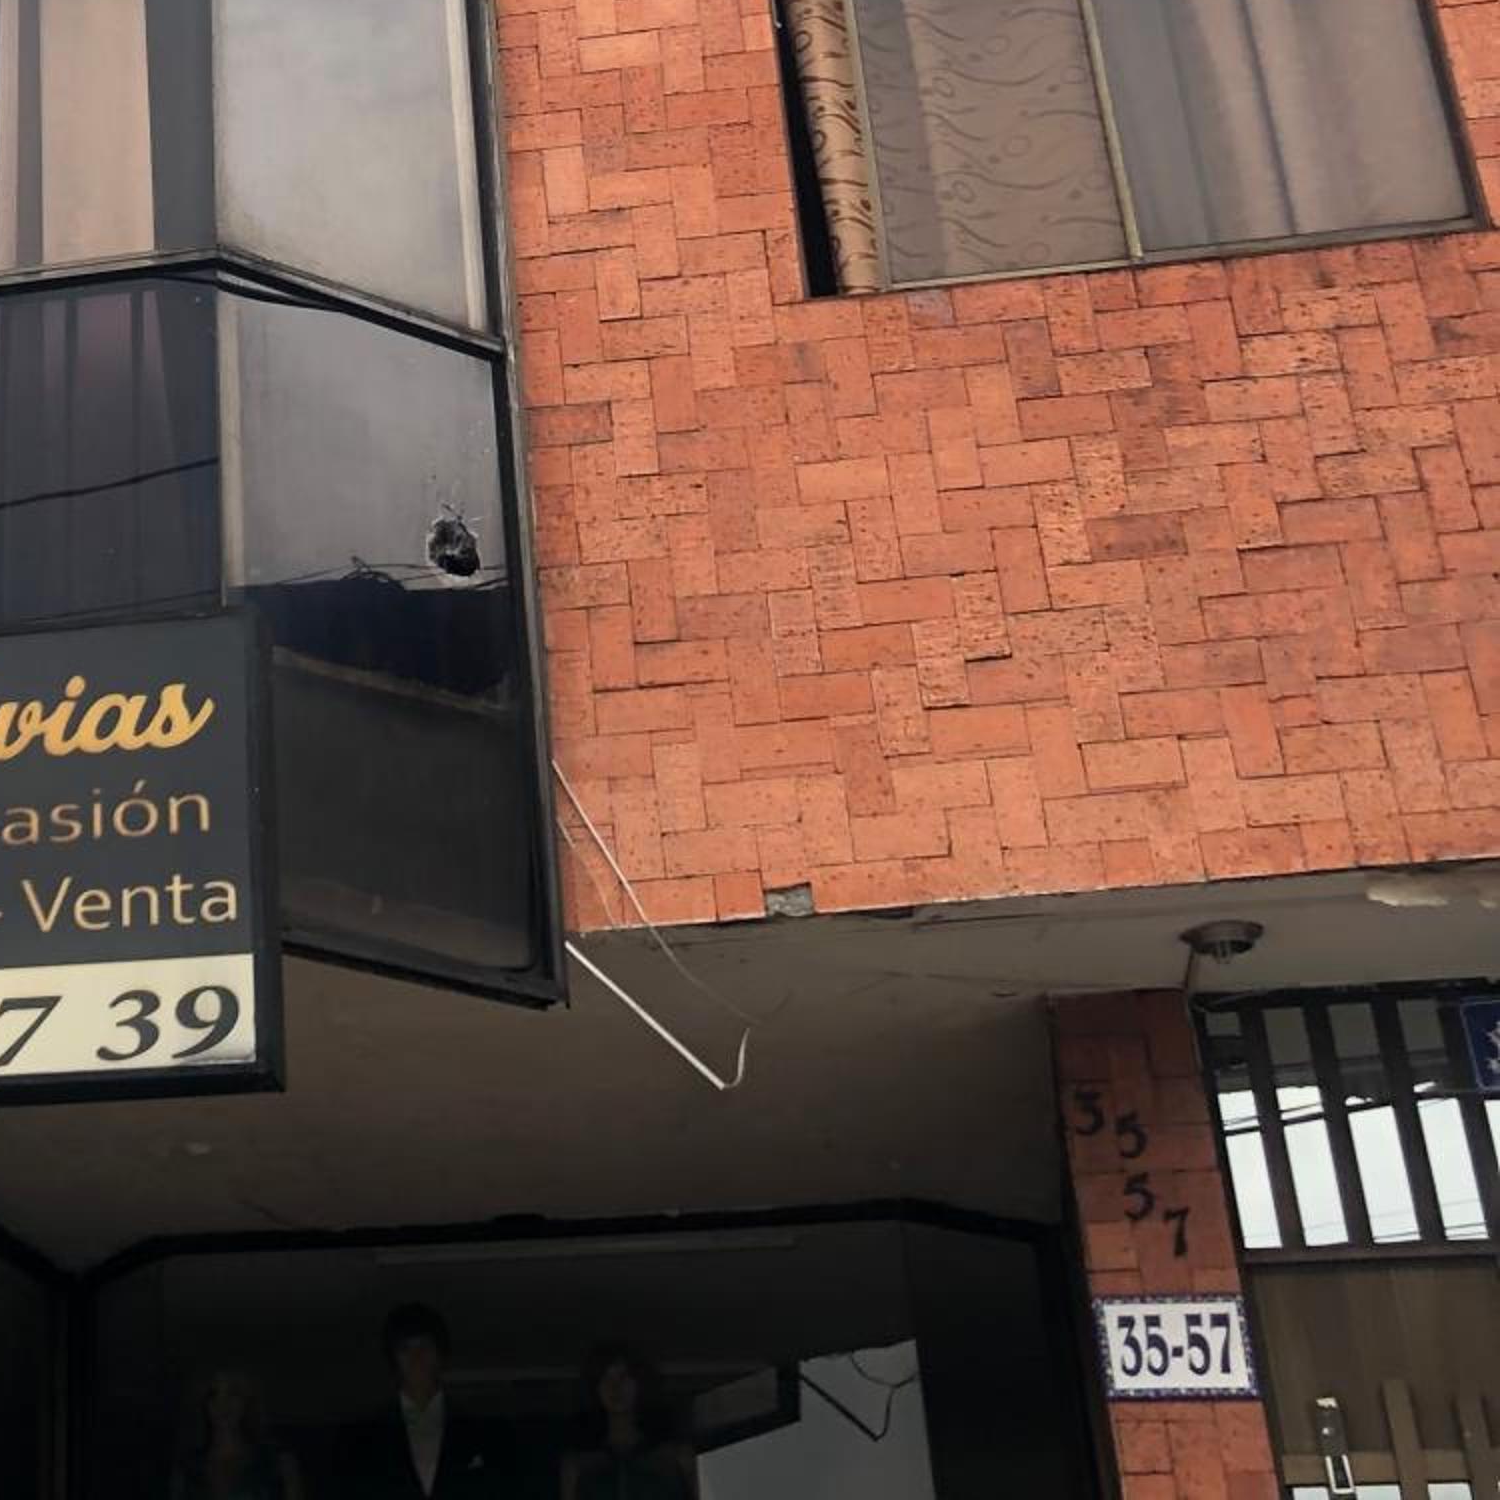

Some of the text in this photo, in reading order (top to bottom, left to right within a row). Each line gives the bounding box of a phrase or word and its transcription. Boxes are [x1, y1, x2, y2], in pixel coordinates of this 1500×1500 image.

[22, 873, 238, 933] Venta
[97, 985, 241, 1063] 39
[1117, 1313, 1233, 1377] 35-57
